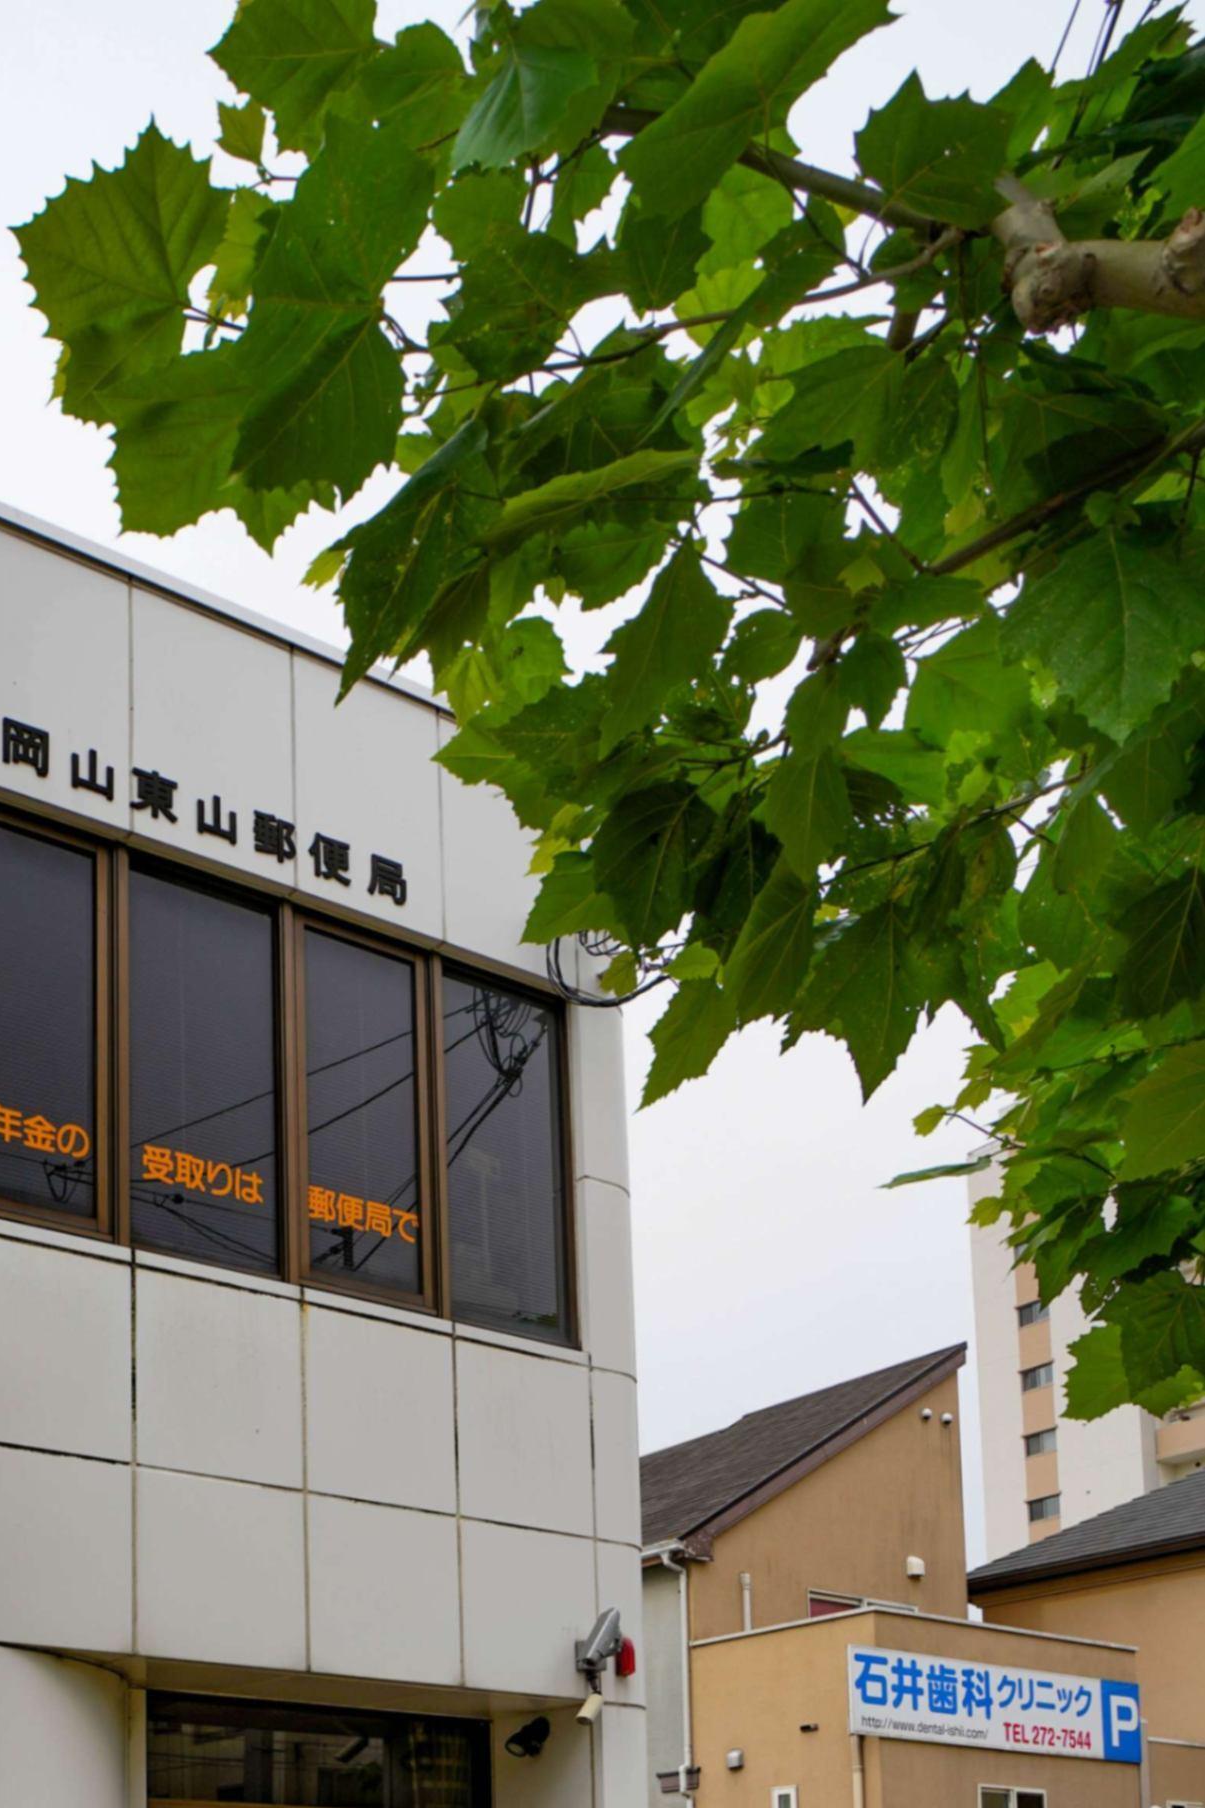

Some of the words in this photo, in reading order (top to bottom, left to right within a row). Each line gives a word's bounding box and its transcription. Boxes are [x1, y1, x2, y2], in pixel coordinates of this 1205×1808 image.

[2, 716, 408, 906] 岡山東山郵便局
[141, 1144, 263, 1205] 受取りは
[306, 1184, 419, 1245] 郵便局で
[854, 1652, 1092, 1720] 石井歯科クリニック
[1003, 1722, 1029, 1745] TEL
[1032, 1726, 1092, 1750] 272-7544
[1111, 1694, 1139, 1747] P
